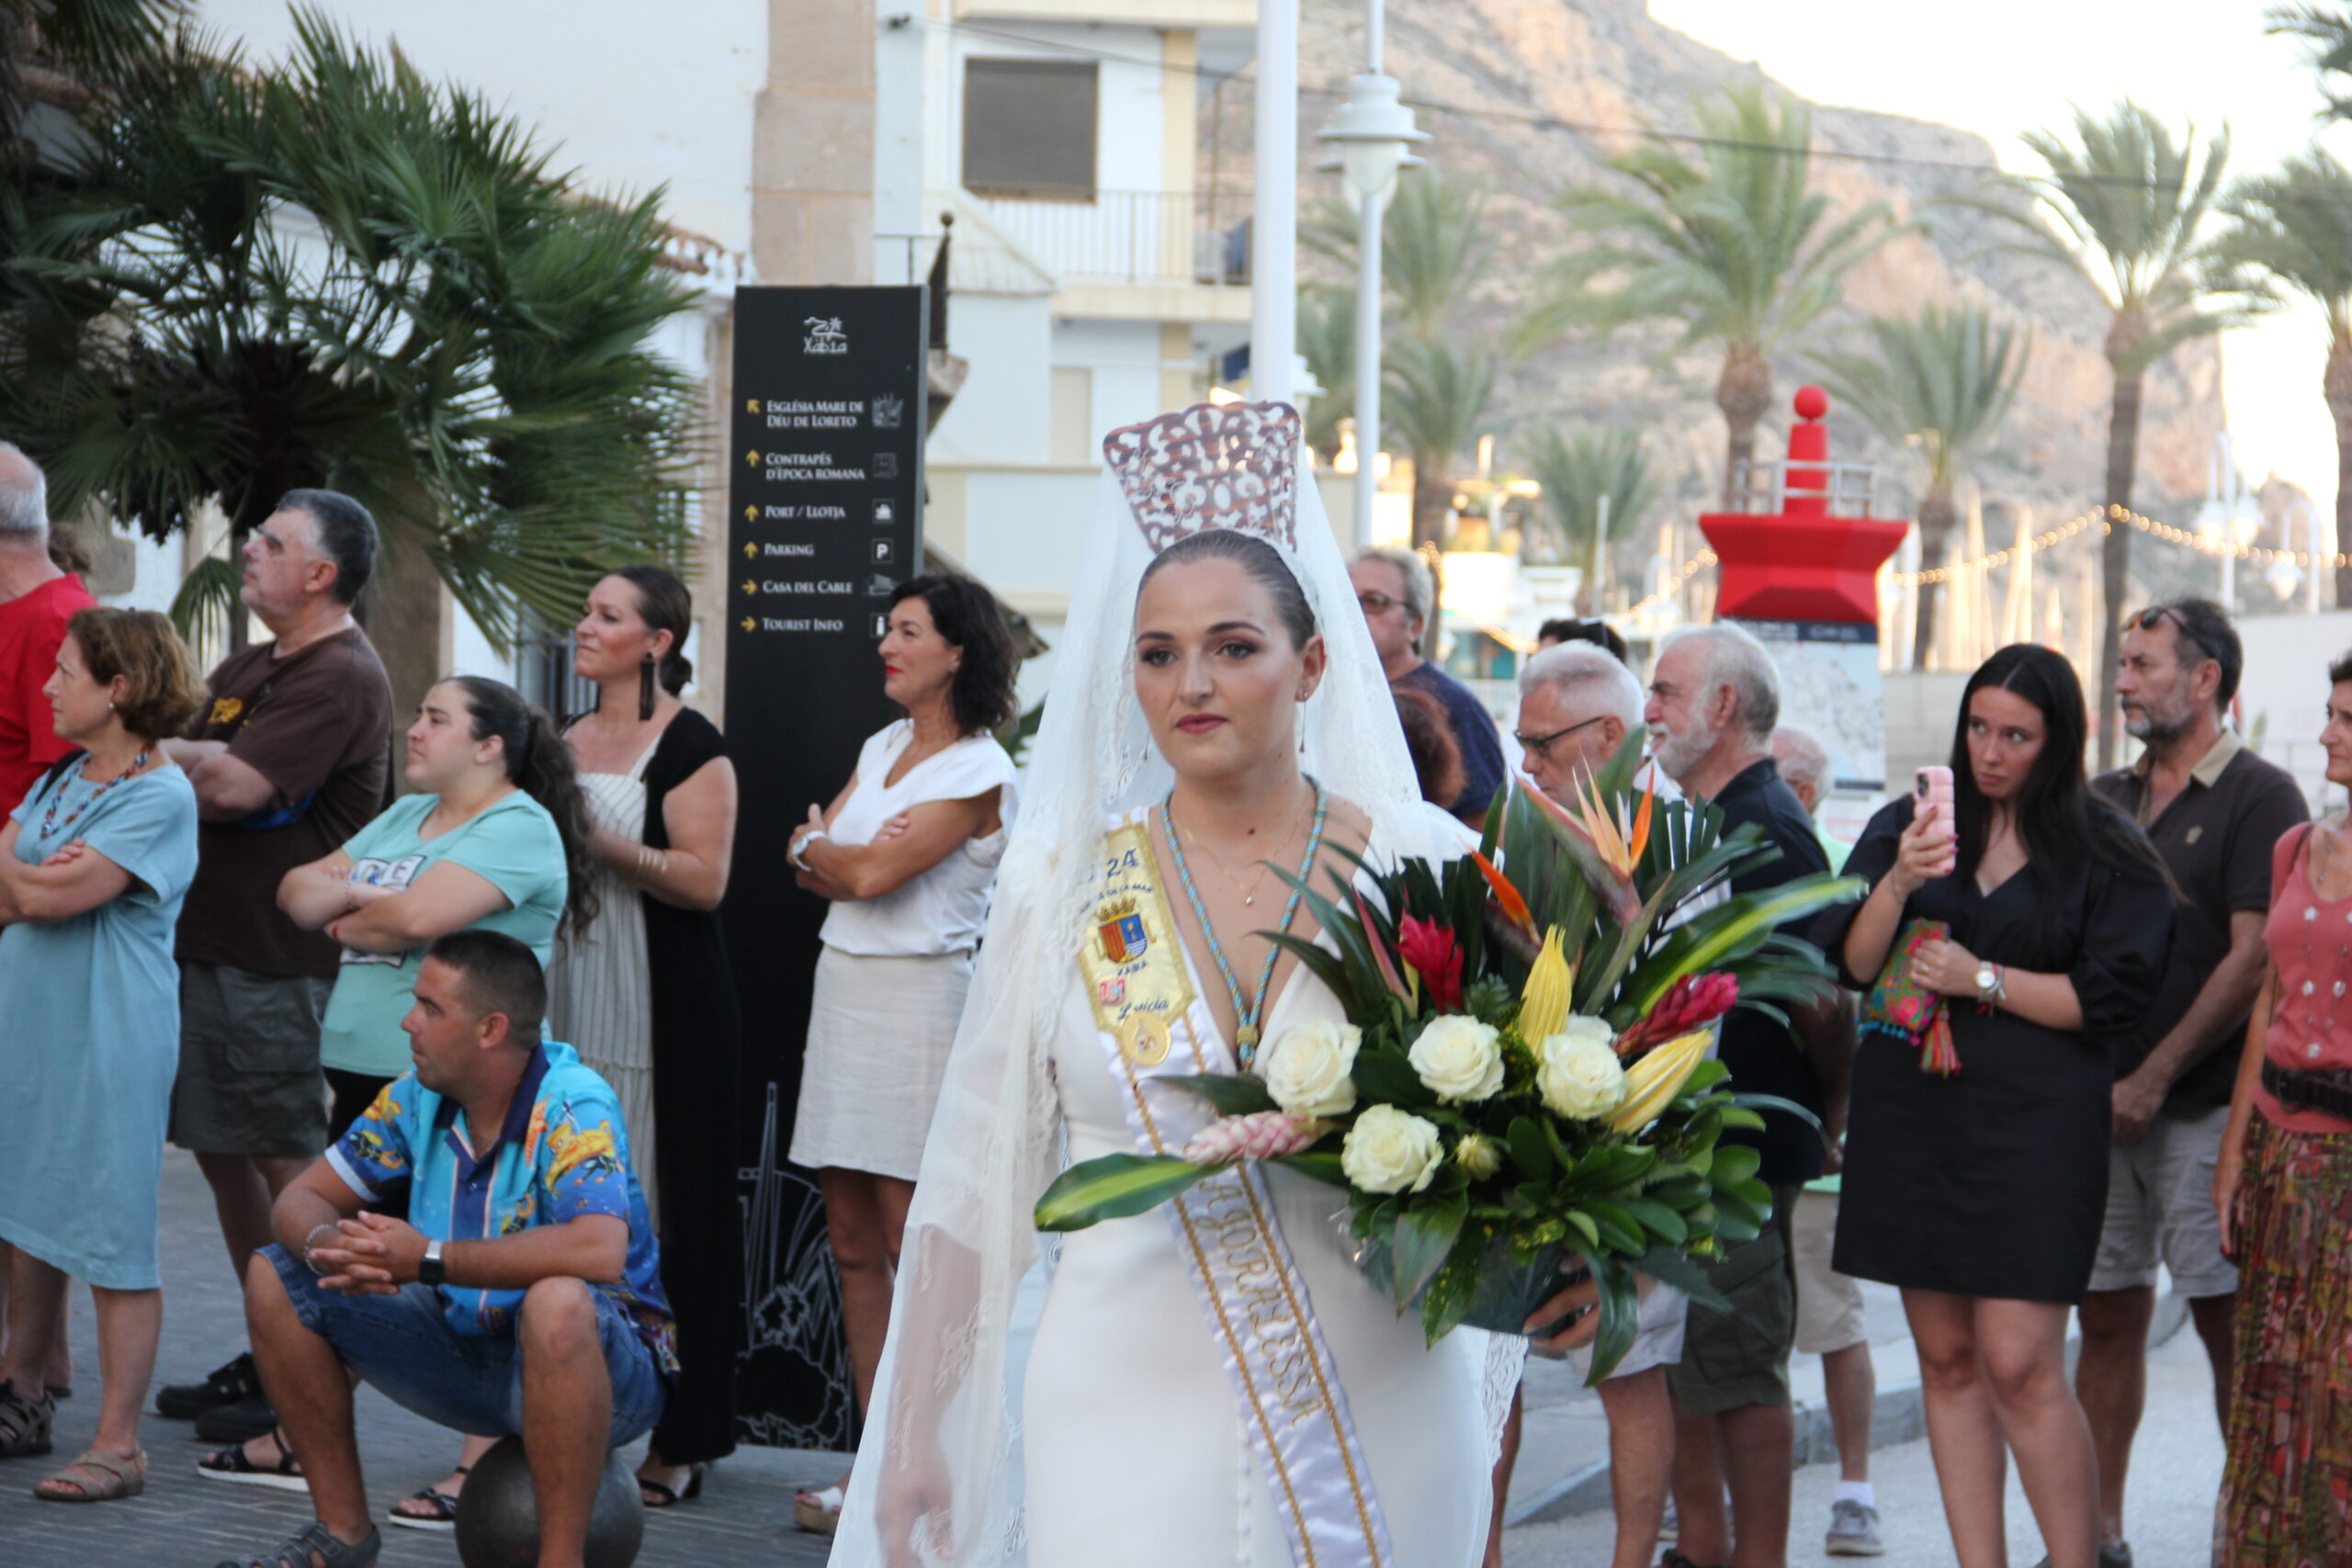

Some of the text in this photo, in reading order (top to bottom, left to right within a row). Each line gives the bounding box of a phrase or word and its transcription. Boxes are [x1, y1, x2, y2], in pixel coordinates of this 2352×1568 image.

[766, 399, 865, 413] ESGLÉSIA MARE DE
[793, 416, 809, 428] DE
[811, 415, 858, 428] LORETO
[765, 451, 833, 466] CONTRAPÉS
[815, 469, 865, 480] ROMANA
[764, 505, 846, 520] PORT / LLOTJA
[763, 543, 815, 556] PARKING
[876, 543, 889, 559] P
[762, 581, 854, 594] CASA DEL CABLE
[762, 617, 844, 631] TOURIST INFO
